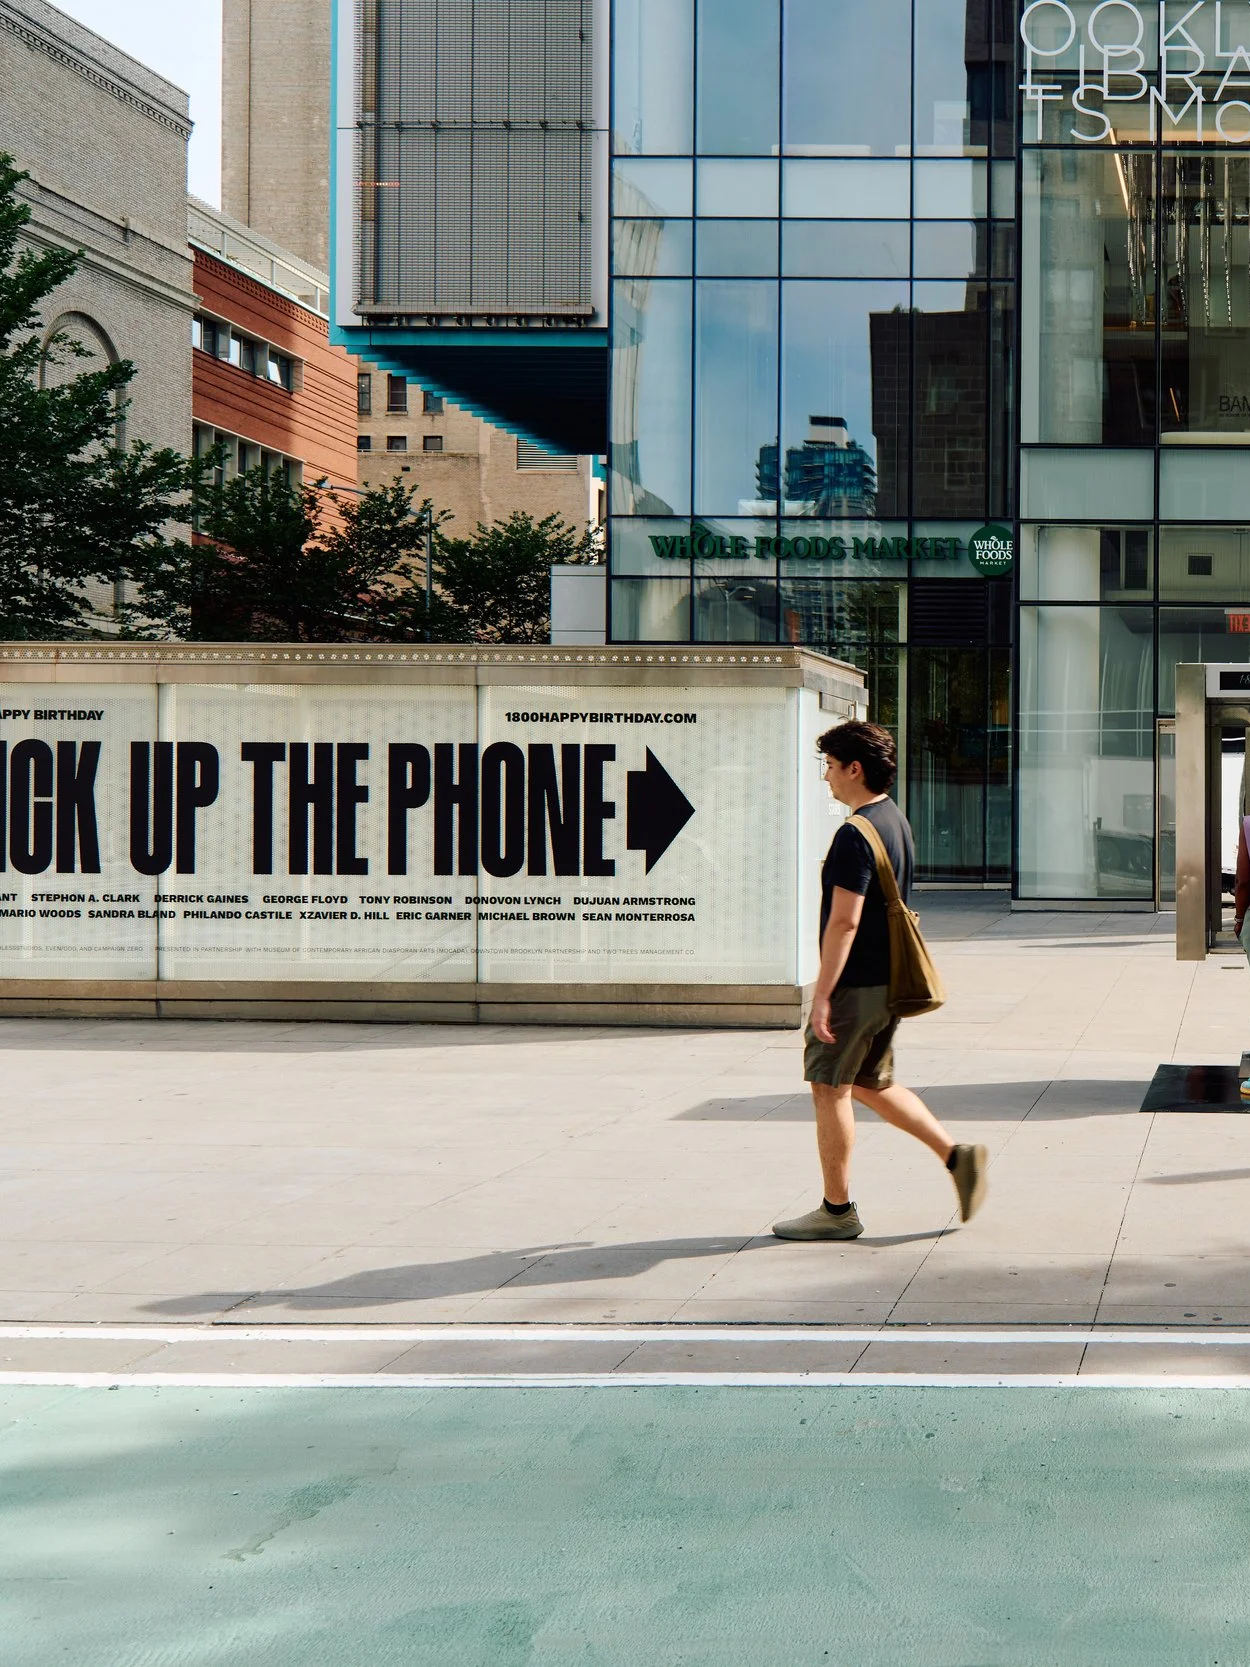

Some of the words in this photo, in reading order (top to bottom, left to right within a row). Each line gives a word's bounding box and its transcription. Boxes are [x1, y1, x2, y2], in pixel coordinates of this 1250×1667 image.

[1018, 84, 1111, 141] TS
[648, 535, 749, 559] WHOLE
[754, 536, 846, 560] FOODS
[851, 536, 962, 560] MARKET
[974, 538, 1013, 550] WHOLE
[976, 550, 1012, 560] FOODS
[0, 709, 31, 720] PPY
[33, 709, 105, 721] BIRTHDAY
[505, 712, 697, 724] 1800HAPPYBIRTHDAY.COM
[130, 740, 219, 876] UP
[241, 742, 369, 876] THE
[388, 741, 616, 877] PHONE
[31, 893, 86, 903] STEPHON
[88, 893, 99, 903] A.
[102, 894, 140, 903] CLARK
[154, 894, 204, 903] DERRICK
[207, 894, 249, 904] GAINES
[263, 895, 309, 904] GEORGE
[311, 895, 348, 904] FLOYD
[359, 895, 391, 904] TONY
[393, 895, 453, 905] ROBINSON
[465, 896, 521, 905] DONOVON
[524, 896, 561, 905] LYNCH
[573, 896, 620, 906] DUJUAN
[622, 896, 696, 906] ARMSTRONG
[0, 909, 37, 918] MARIO
[39, 909, 82, 919] WOODS
[88, 909, 134, 919] SANDRA
[137, 910, 176, 919] BLAND
[183, 910, 242, 919] PHILANDO
[245, 911, 293, 920] CASTILE
[299, 911, 347, 920] XZAVIER
[350, 911, 361, 920] D.
[364, 911, 390, 920] HILL
[396, 911, 422, 921] ERIC
[425, 912, 472, 921] GARNER
[478, 912, 529, 921] MICHAEL
[532, 912, 576, 921] BROWN
[582, 912, 612, 922] SEAN
[615, 912, 696, 922] MONTERROSA
